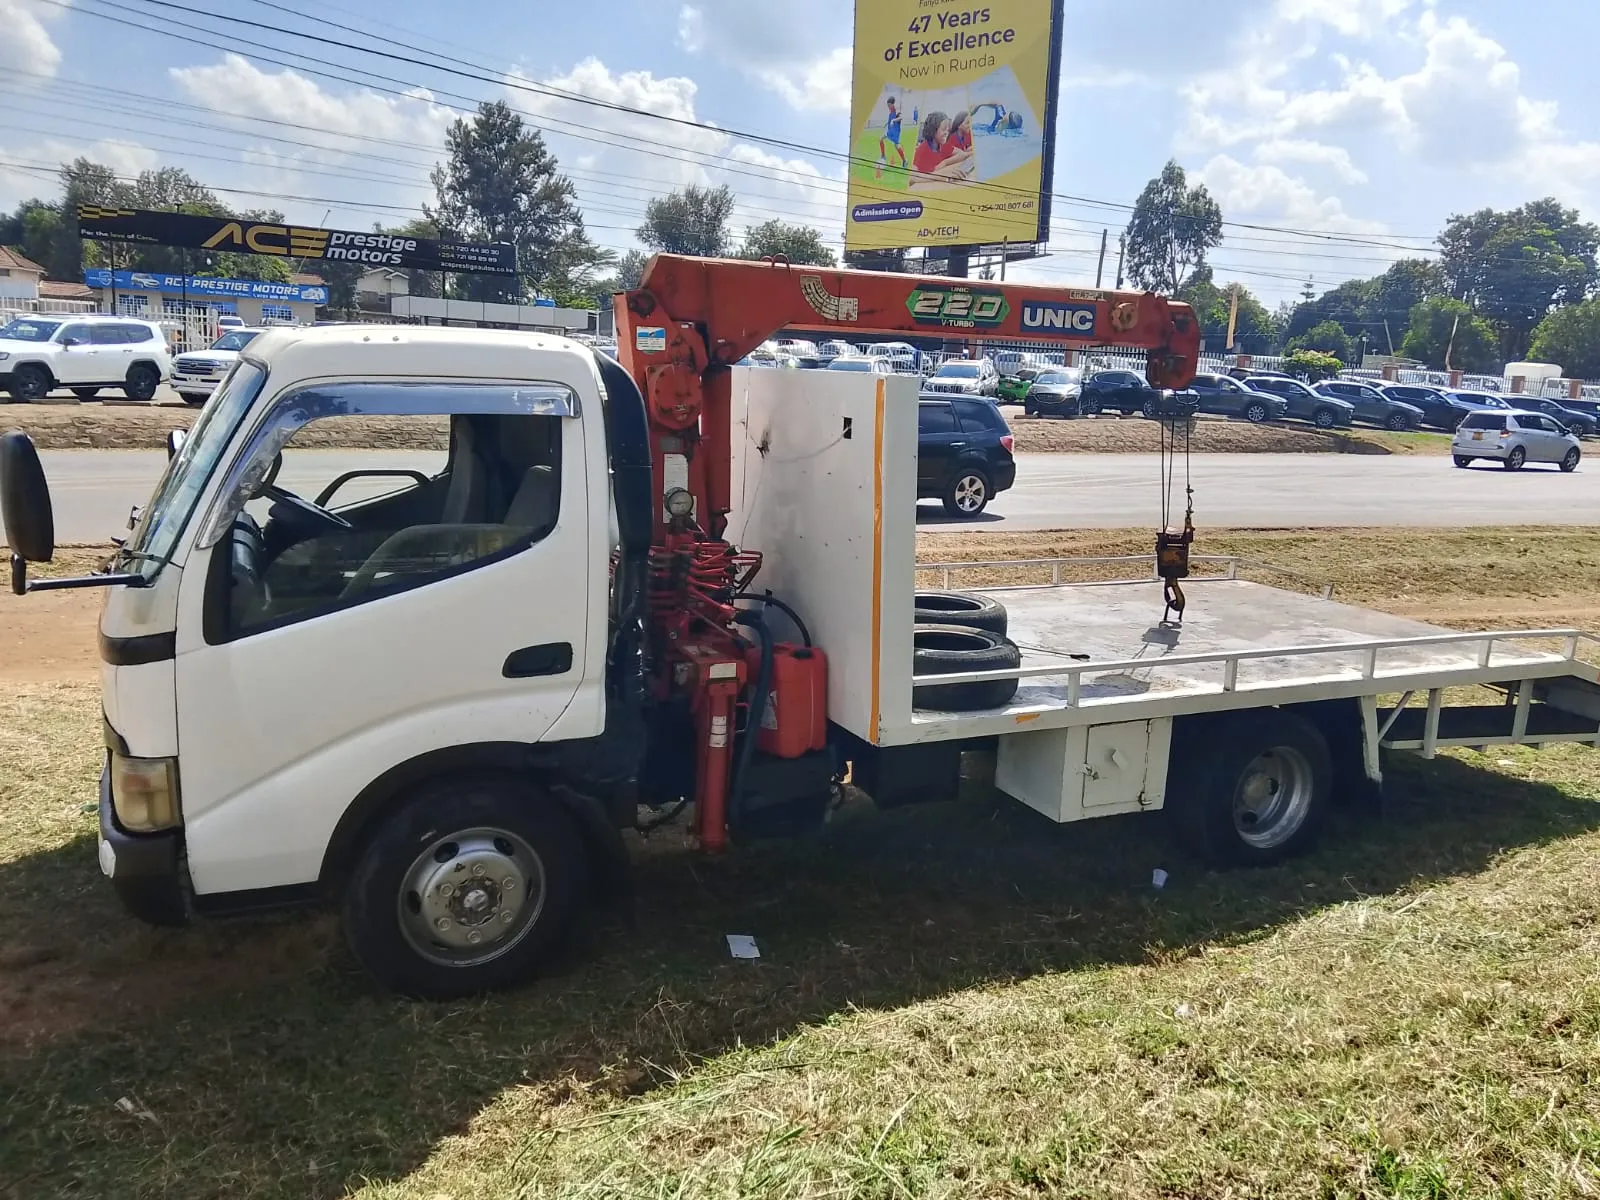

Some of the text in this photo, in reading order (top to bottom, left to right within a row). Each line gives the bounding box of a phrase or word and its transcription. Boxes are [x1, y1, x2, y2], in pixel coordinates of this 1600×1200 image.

[908, 7, 991, 34] 47 Years
[884, 28, 1016, 62] of Excellence
[899, 53, 996, 80] Now in Runda
[854, 206, 921, 217] Admissions Open
[201, 222, 330, 258] ACE
[330, 232, 417, 251] prestige
[326, 247, 403, 264] motors
[164, 277, 300, 296] ACE PRESTIGE MOTORS
[914, 292, 1002, 317] 220
[1023, 307, 1093, 331] UNIC
